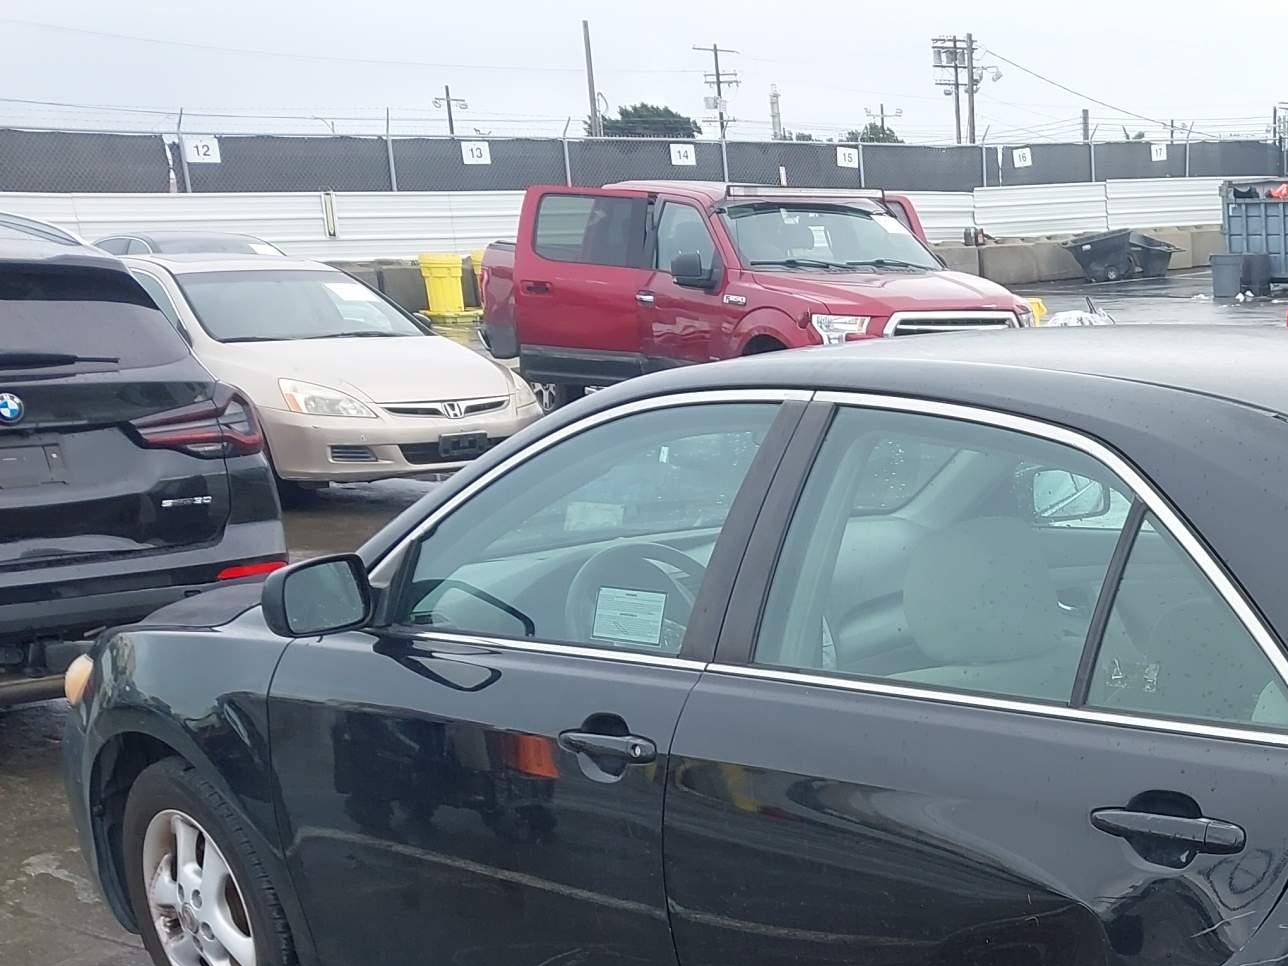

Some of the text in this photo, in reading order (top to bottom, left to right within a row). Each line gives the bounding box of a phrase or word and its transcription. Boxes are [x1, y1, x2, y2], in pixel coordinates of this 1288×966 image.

[193, 144, 211, 157] 12
[469, 147, 483, 159] 13
[677, 149, 689, 160] 14
[843, 152, 853, 163] 15
[1018, 152, 1027, 162] 16
